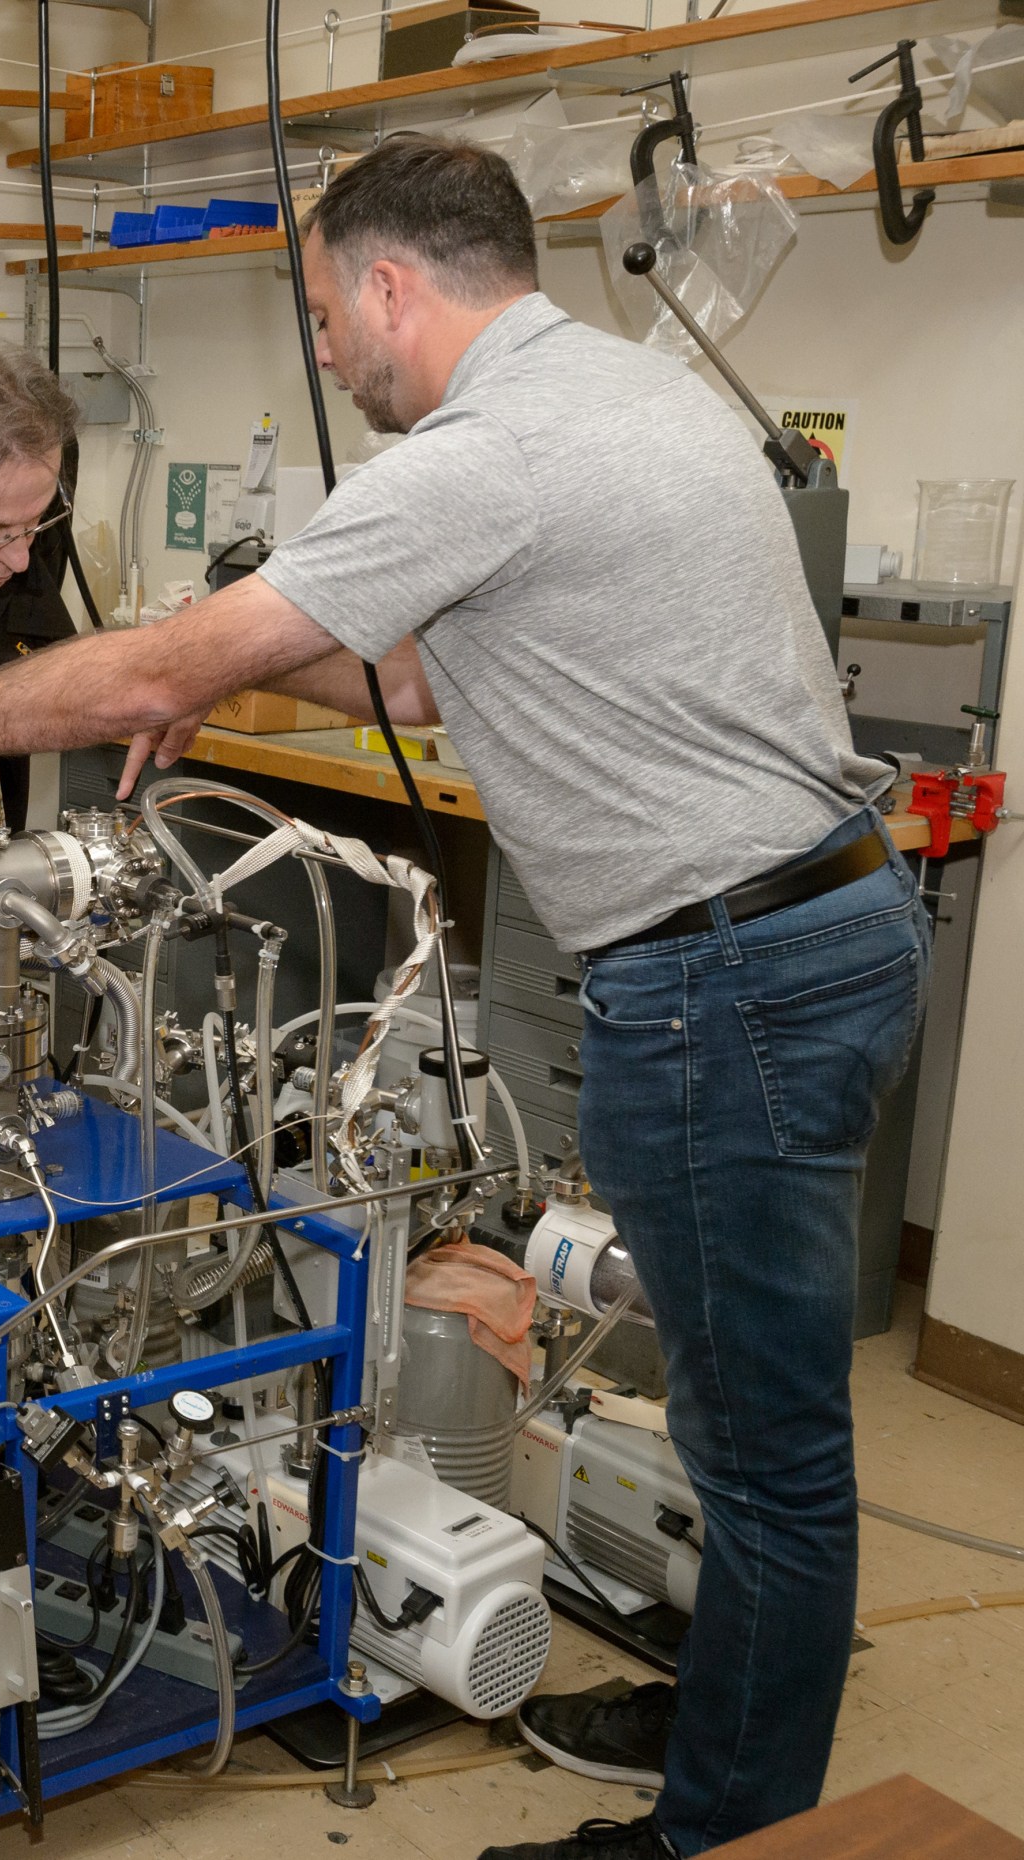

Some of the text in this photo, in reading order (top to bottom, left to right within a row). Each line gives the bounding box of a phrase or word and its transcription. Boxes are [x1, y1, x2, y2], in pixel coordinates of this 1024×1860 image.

[781, 411, 845, 430] CAUTION
[555, 1242, 569, 1274] TRAP
[522, 1429, 559, 1453] EDWARDS
[272, 1498, 309, 1523] EDWARDS
